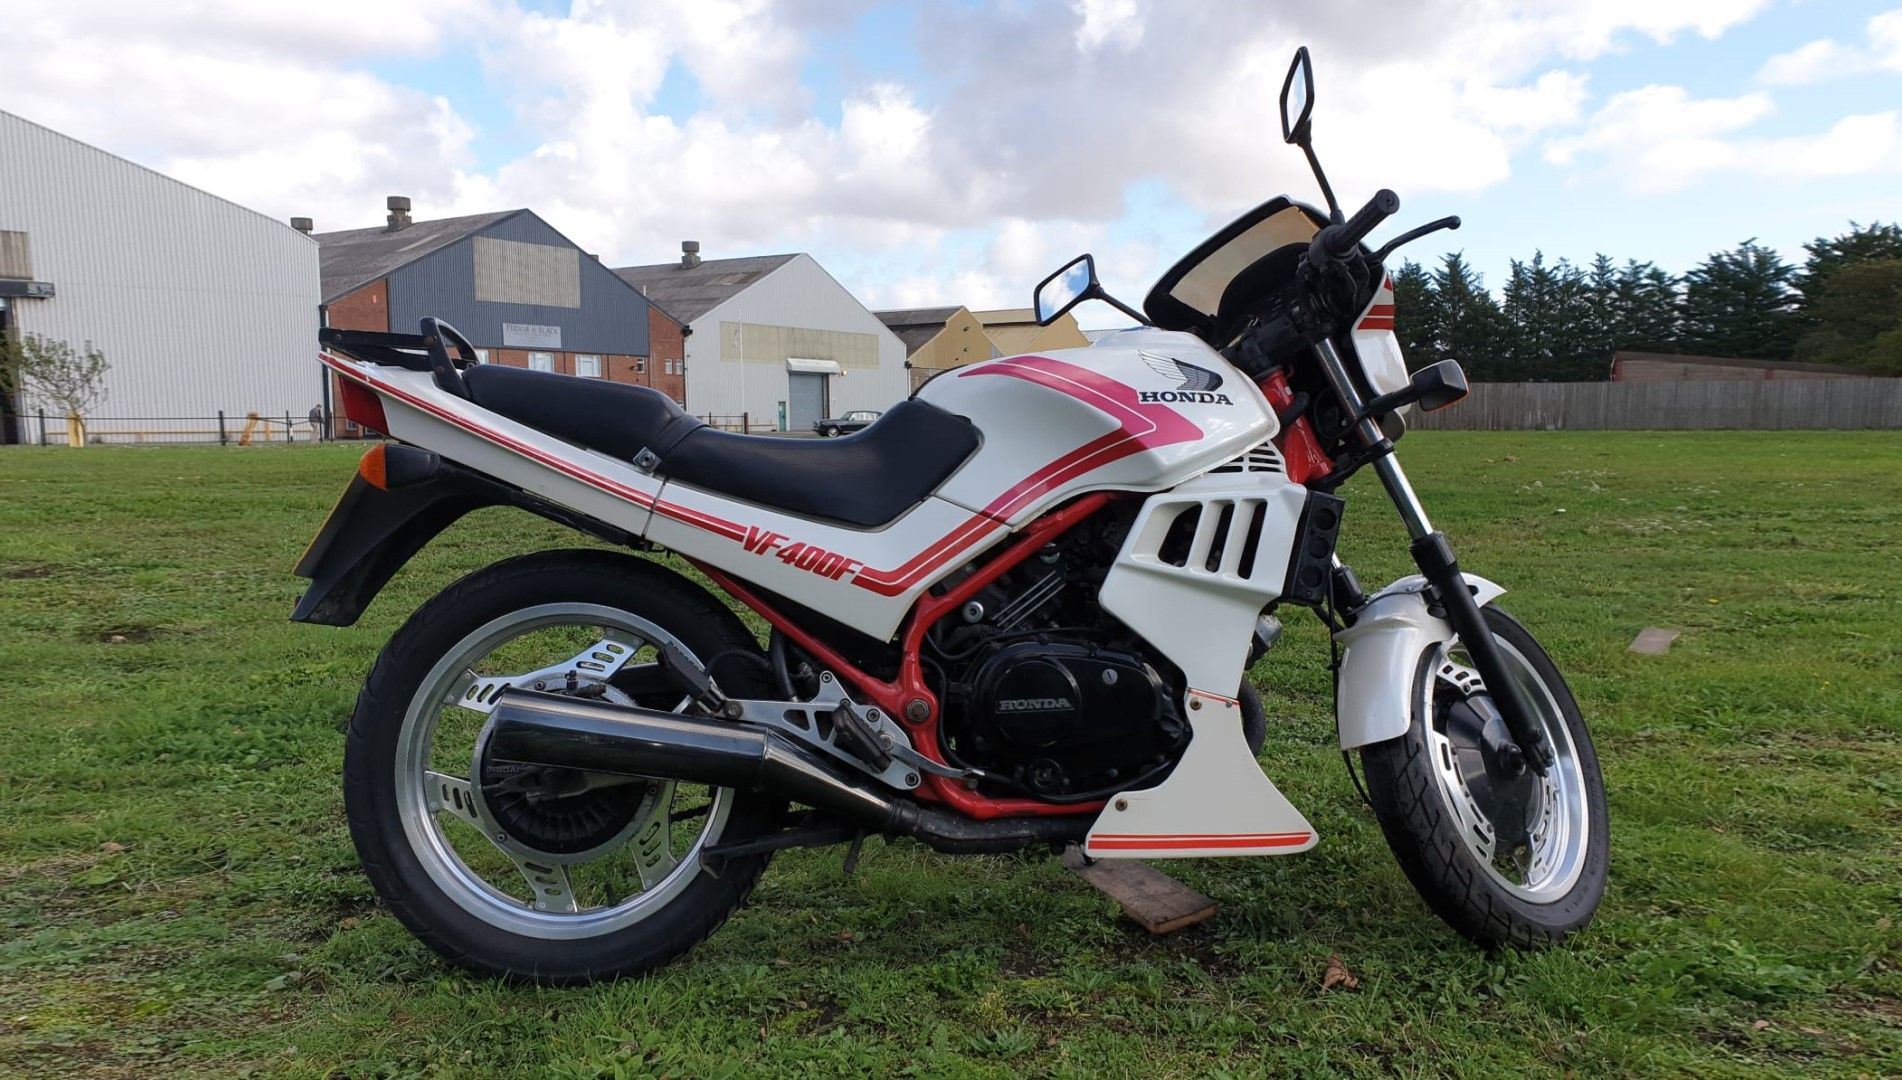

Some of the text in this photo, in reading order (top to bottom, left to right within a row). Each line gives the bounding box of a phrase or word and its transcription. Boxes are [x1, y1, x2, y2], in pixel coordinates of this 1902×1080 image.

[1139, 391, 1233, 406] HONDA
[743, 525, 864, 581] VF400F
[998, 697, 1072, 711] HONDA
